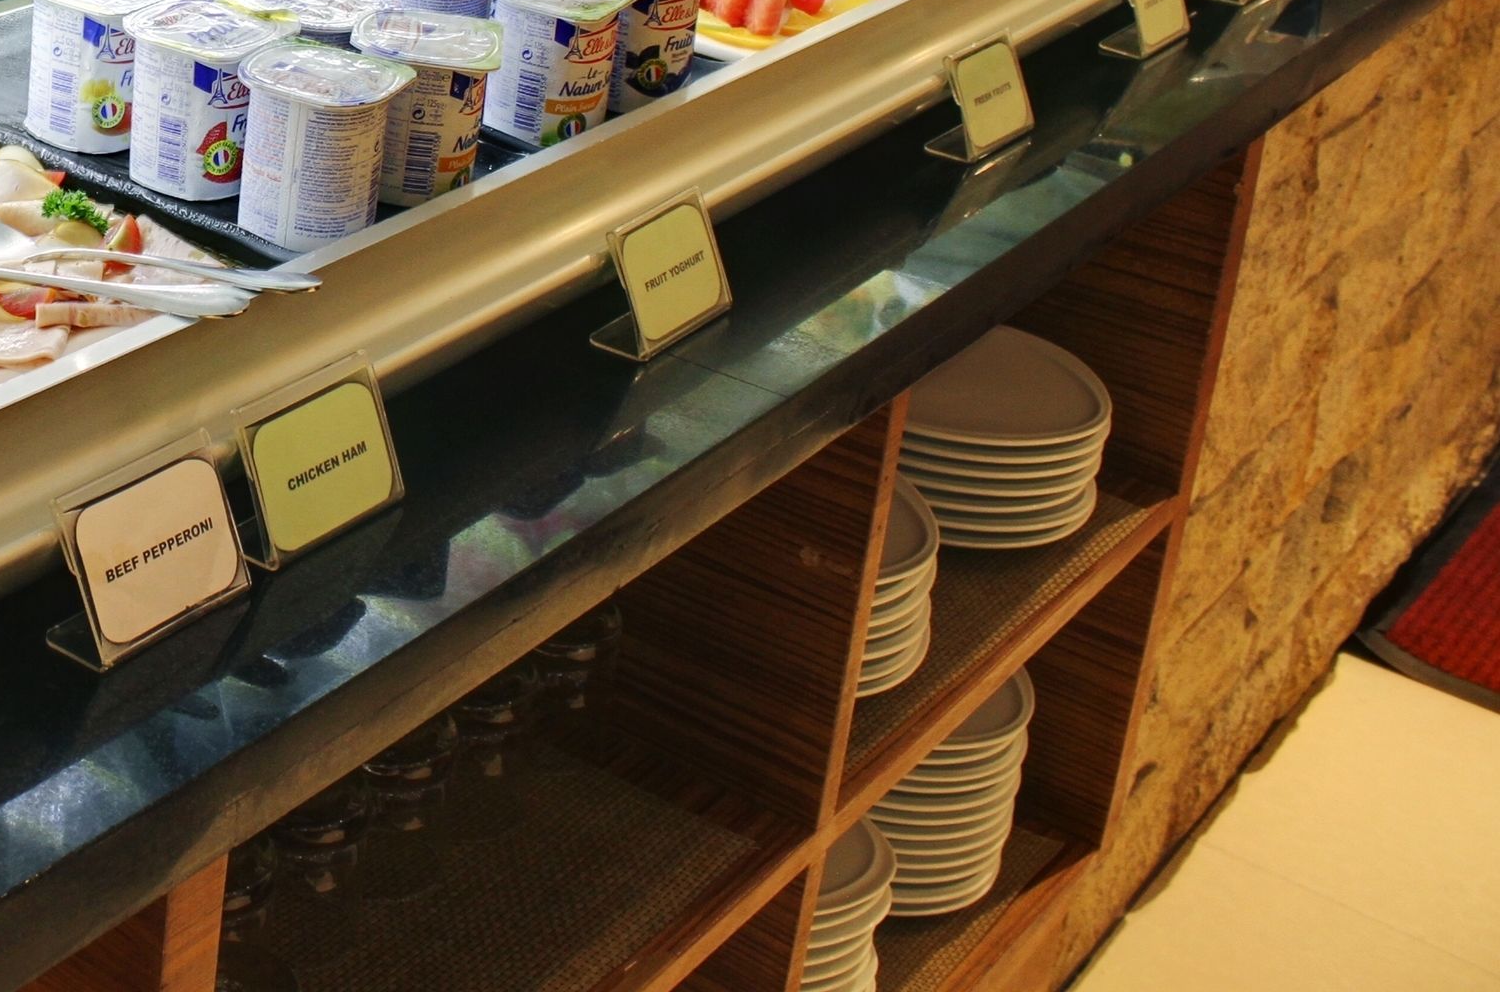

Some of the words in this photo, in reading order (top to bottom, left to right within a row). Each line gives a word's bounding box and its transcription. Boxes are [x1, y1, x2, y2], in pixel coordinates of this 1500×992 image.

[644, 271, 669, 293] FRUIT
[669, 250, 706, 278] YOGHURT
[287, 455, 340, 491] CHICKEN
[342, 440, 368, 464] HAM
[104, 555, 140, 584] BEEF
[141, 516, 214, 564] PEPPERONI
